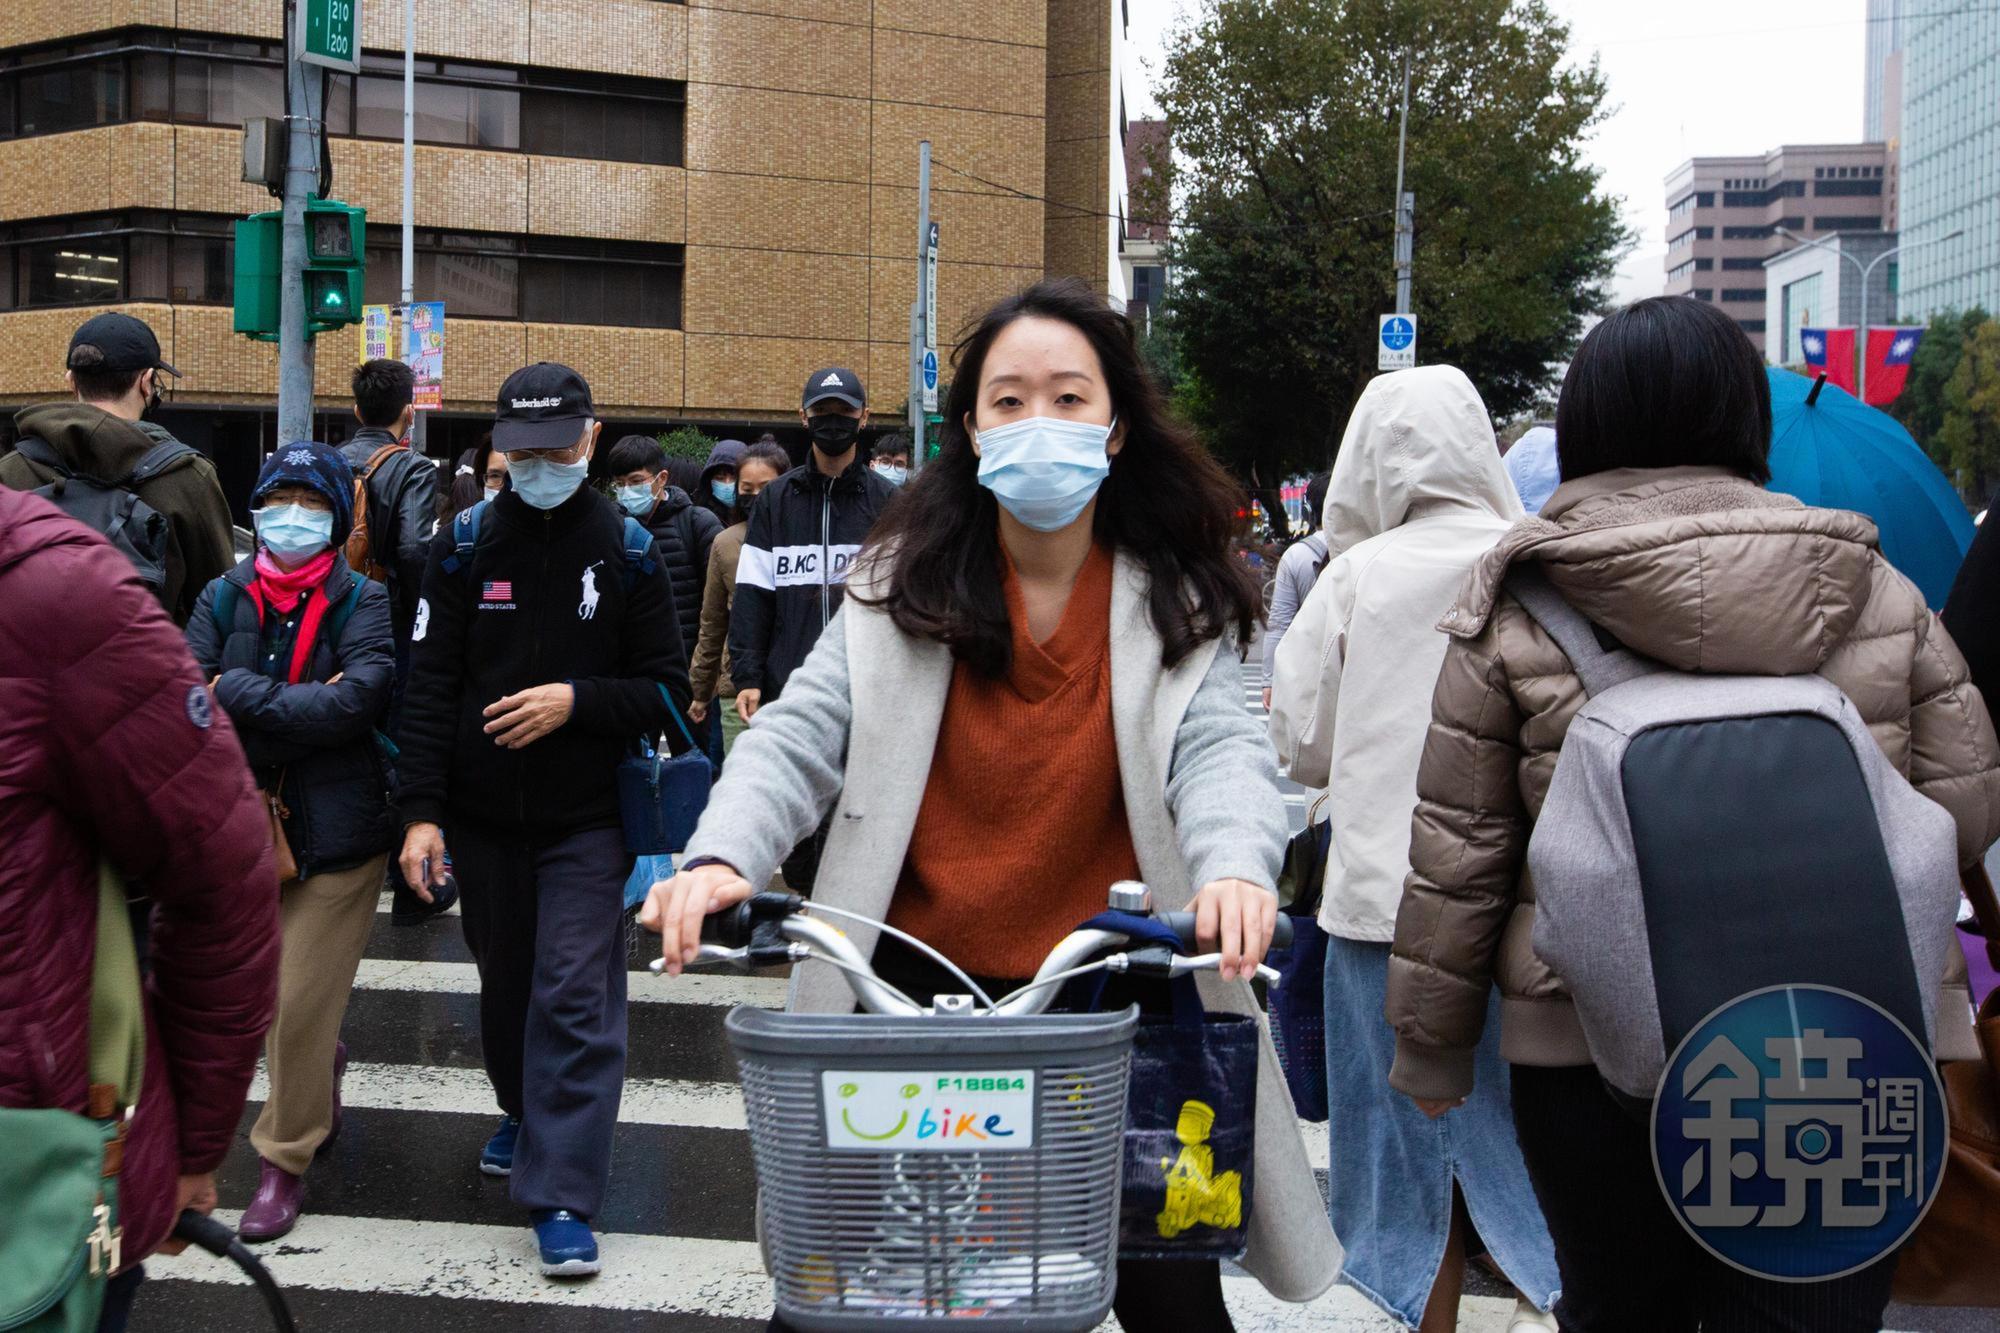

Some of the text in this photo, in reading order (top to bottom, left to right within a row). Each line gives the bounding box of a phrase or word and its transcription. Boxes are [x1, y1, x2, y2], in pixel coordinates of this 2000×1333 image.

[331, 1, 349, 22] 210
[330, 33, 348, 54] 200
[511, 397, 550, 409] Timberland
[776, 553, 817, 575] B.KC
